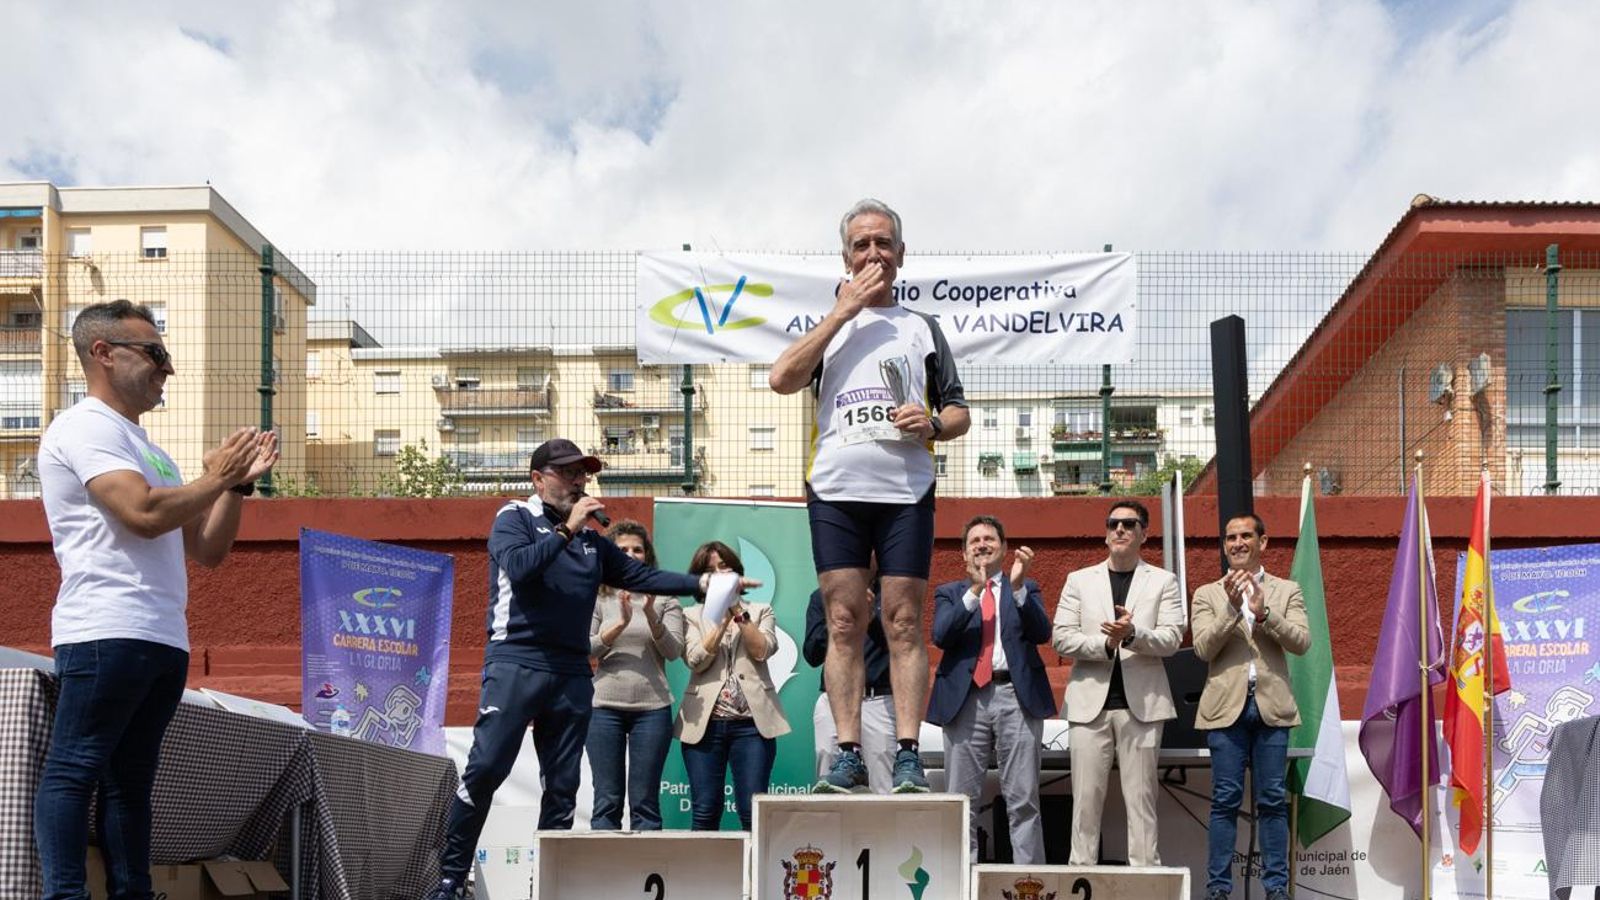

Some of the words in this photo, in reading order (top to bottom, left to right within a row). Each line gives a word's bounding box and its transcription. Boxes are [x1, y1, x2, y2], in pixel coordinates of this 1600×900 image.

[932, 279, 1077, 308] Cooperativa
[953, 310, 1124, 334] VANDELVIRA
[338, 609, 415, 639] XXXVI
[332, 633, 376, 652] CARRERA
[378, 639, 419, 657] ESCOLAR
[1504, 643, 1537, 657] RRERA
[1539, 641, 1590, 657] ESCOLAR
[1296, 850, 1348, 863] unicipal
[1351, 850, 1367, 861] de
[856, 848, 870, 900] 1
[1300, 865, 1317, 876] de
[1319, 864, 1350, 876] Jaén
